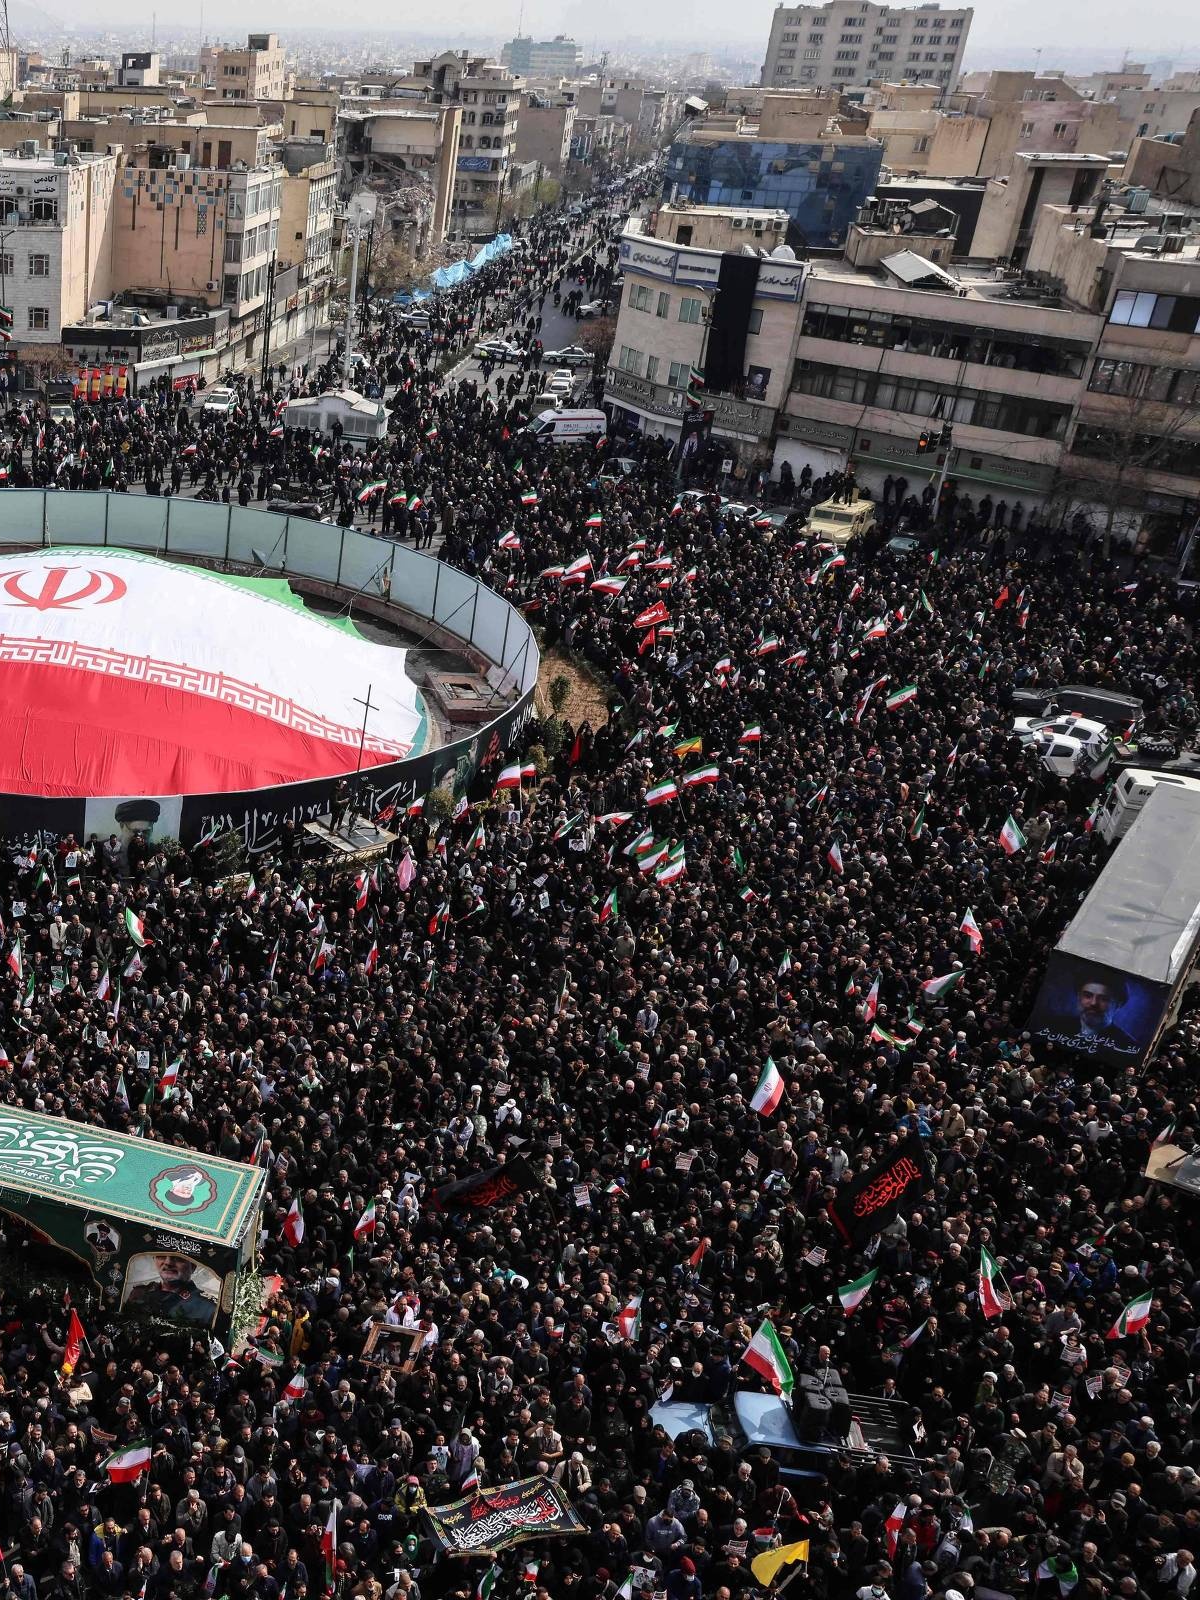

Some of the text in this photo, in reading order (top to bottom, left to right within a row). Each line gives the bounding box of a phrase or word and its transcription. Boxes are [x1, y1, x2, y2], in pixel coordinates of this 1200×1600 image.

[33, 175, 58, 183] آکادمی
[1047, 1032, 1069, 1045] جوان
[1103, 1037, 1116, 1048] خدا
